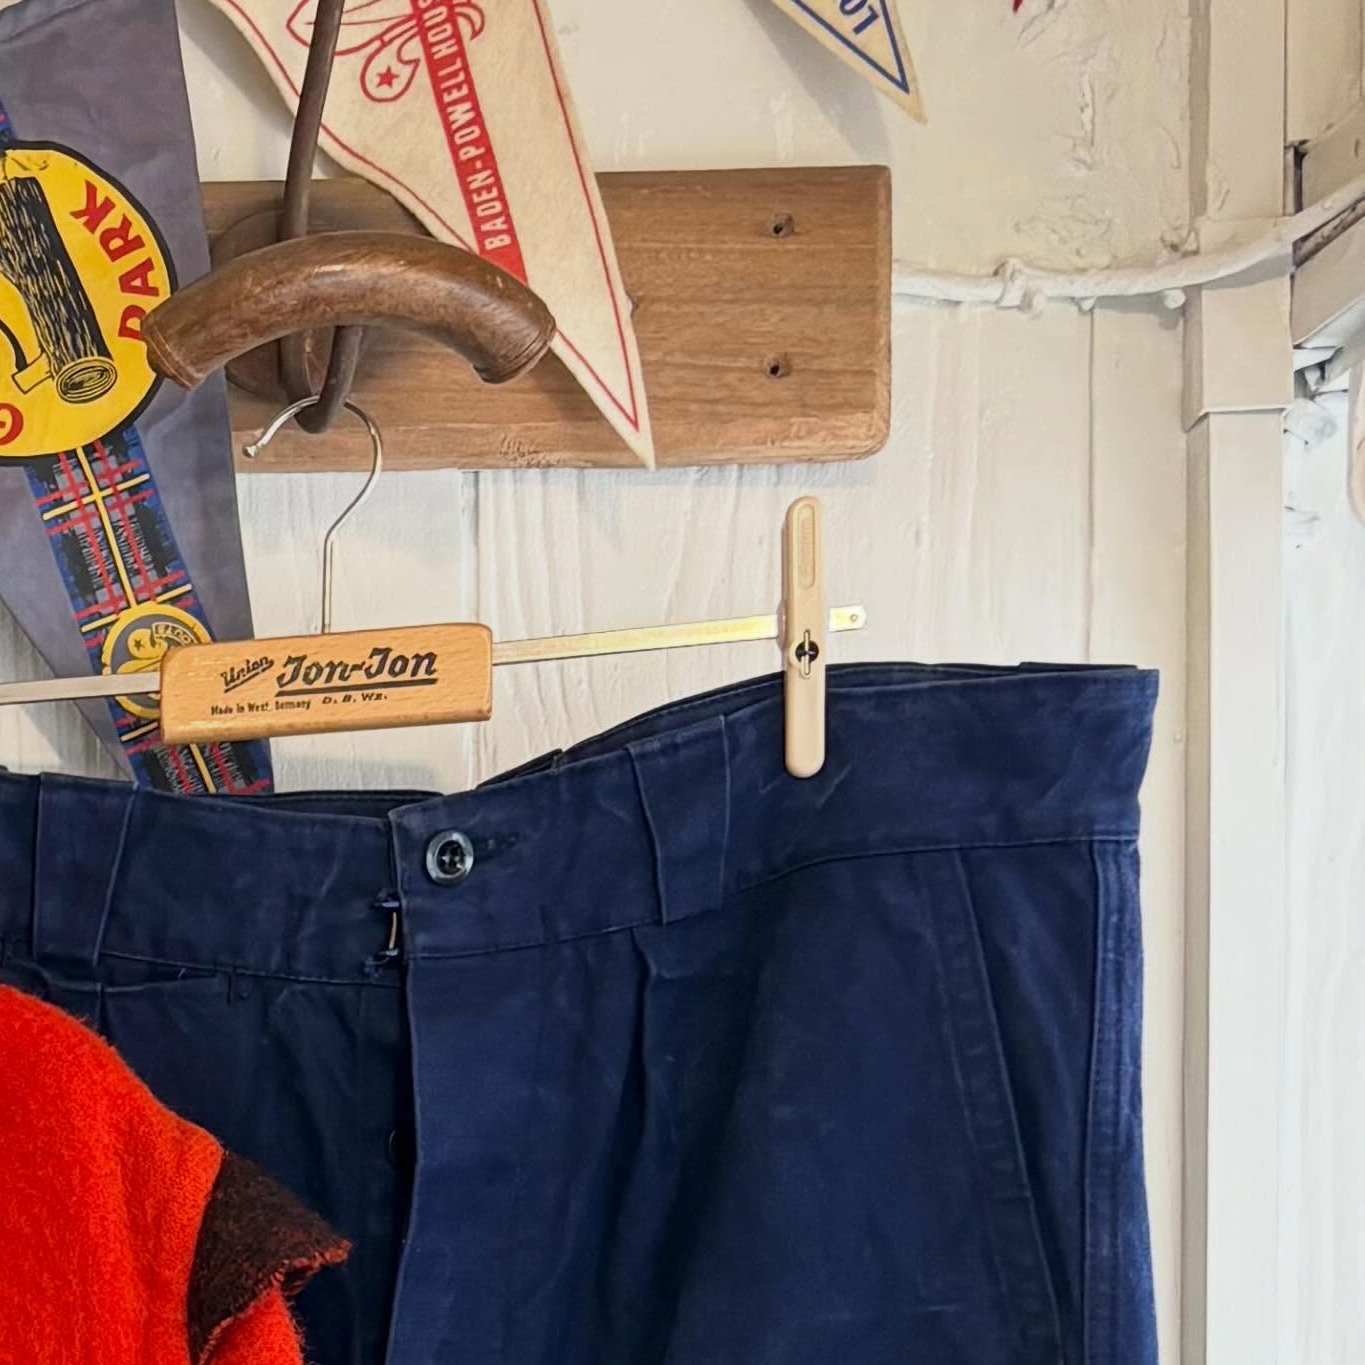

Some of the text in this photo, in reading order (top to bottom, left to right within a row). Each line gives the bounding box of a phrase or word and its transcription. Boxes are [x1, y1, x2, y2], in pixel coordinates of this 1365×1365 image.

[422, 0, 512, 250] BADEN-POWELL HOU
[72, 180, 150, 344] PARK
[220, 655, 275, 690] Union
